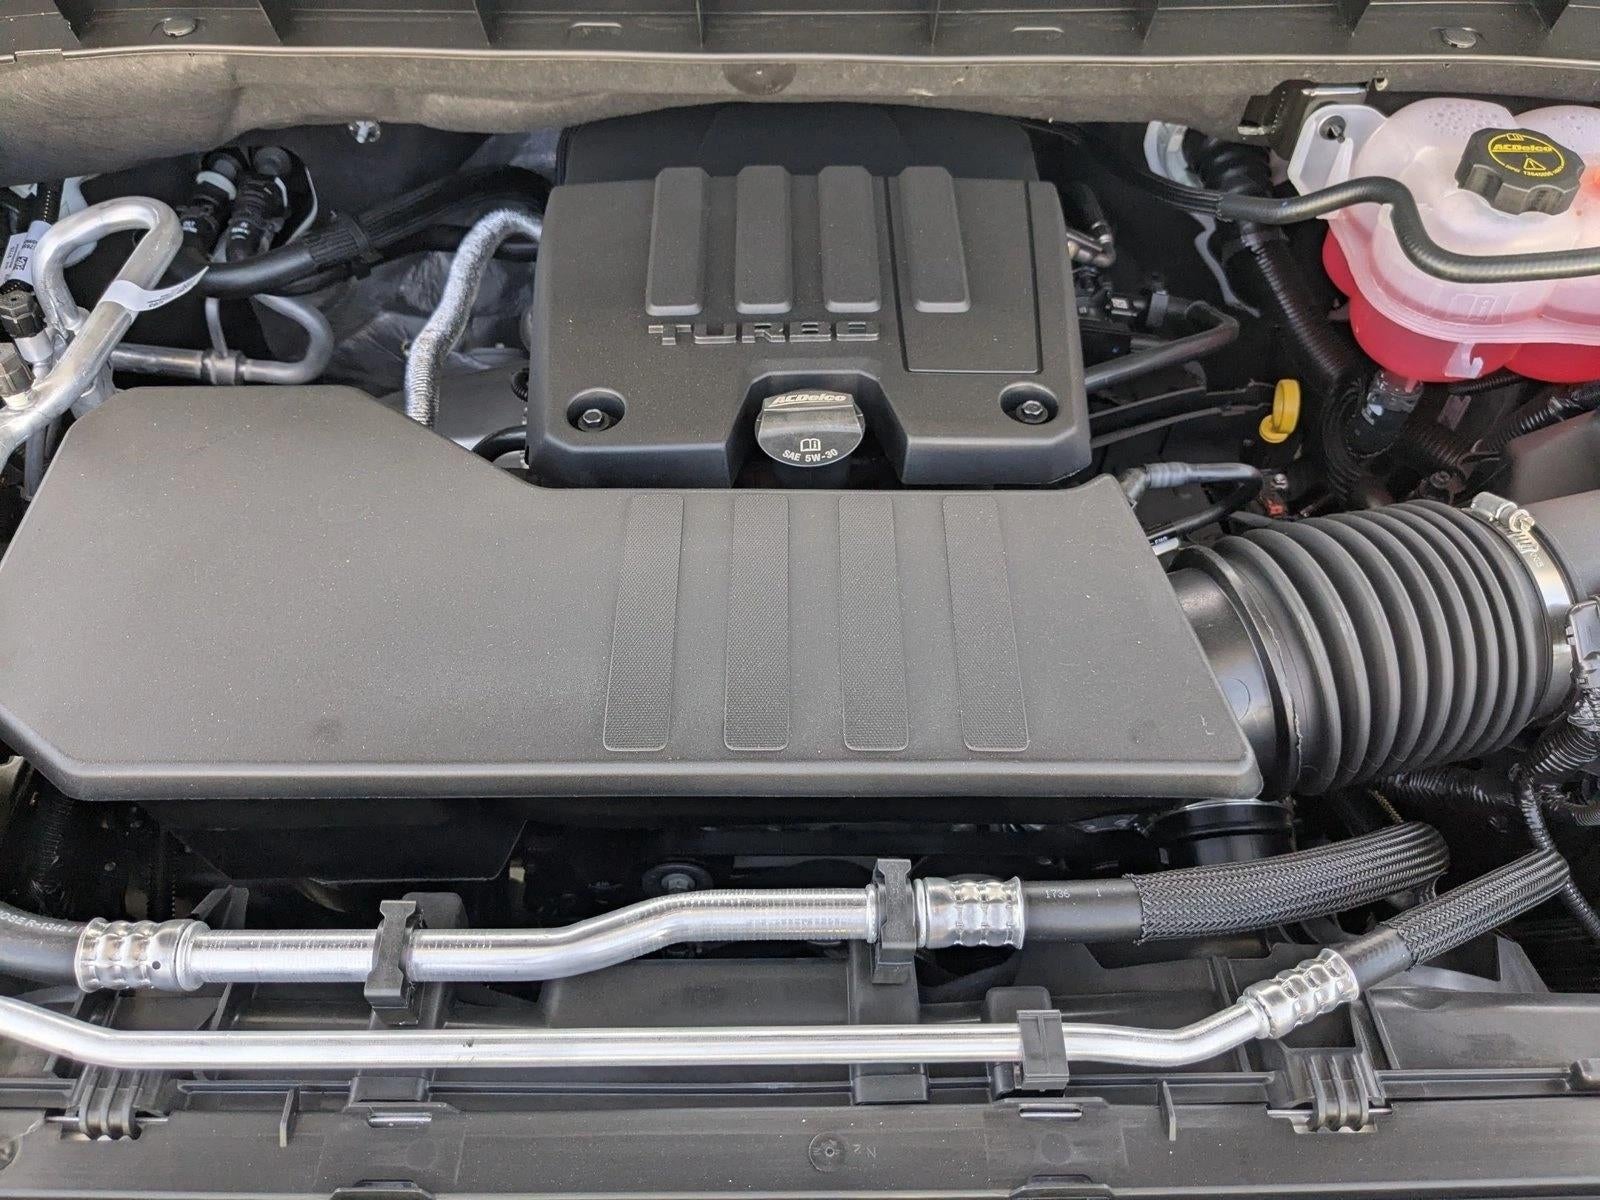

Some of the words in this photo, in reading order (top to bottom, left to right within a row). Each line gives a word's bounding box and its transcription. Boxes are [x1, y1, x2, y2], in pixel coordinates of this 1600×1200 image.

[1492, 143, 1553, 153] ACDelco
[648, 320, 880, 346] TURBO
[770, 393, 847, 407] ACDelco
[782, 449, 801, 463] SAE
[804, 448, 838, 463] 5W-30
